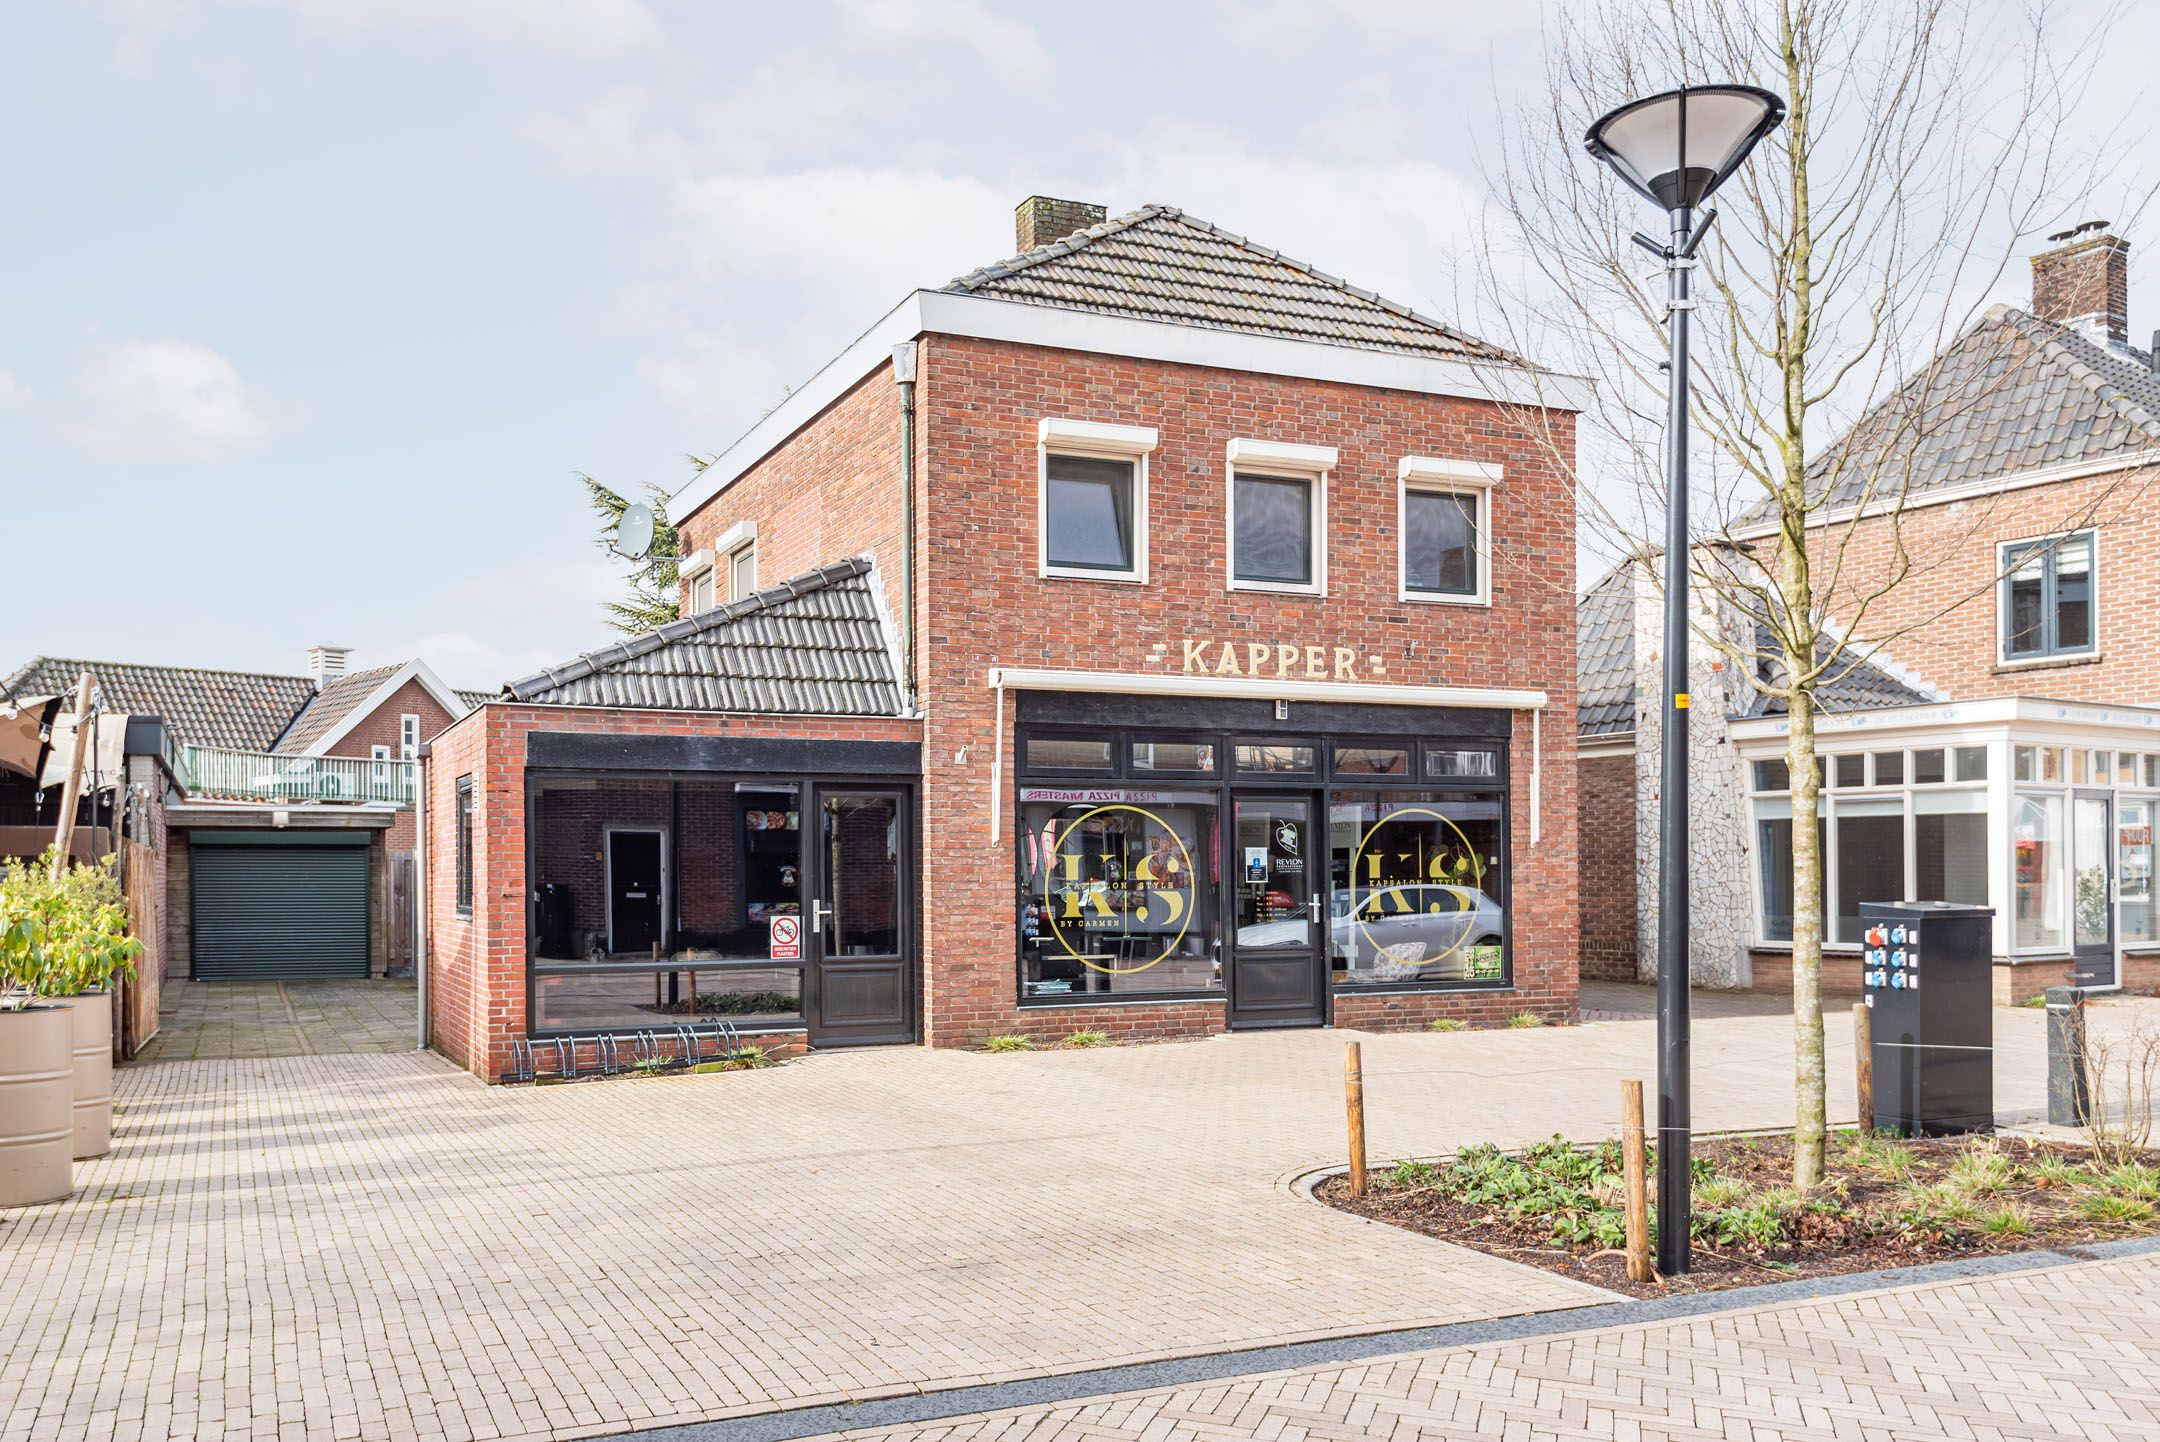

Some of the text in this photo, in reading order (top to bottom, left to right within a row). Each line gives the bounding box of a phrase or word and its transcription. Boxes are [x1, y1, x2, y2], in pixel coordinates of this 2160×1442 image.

[1182, 639, 1359, 680] KAPPER
[1065, 881, 1174, 890] KAPSALON STYLE
[1368, 879, 1423, 887] KAPSALON
[1060, 920, 1121, 928] BY CARMEN
